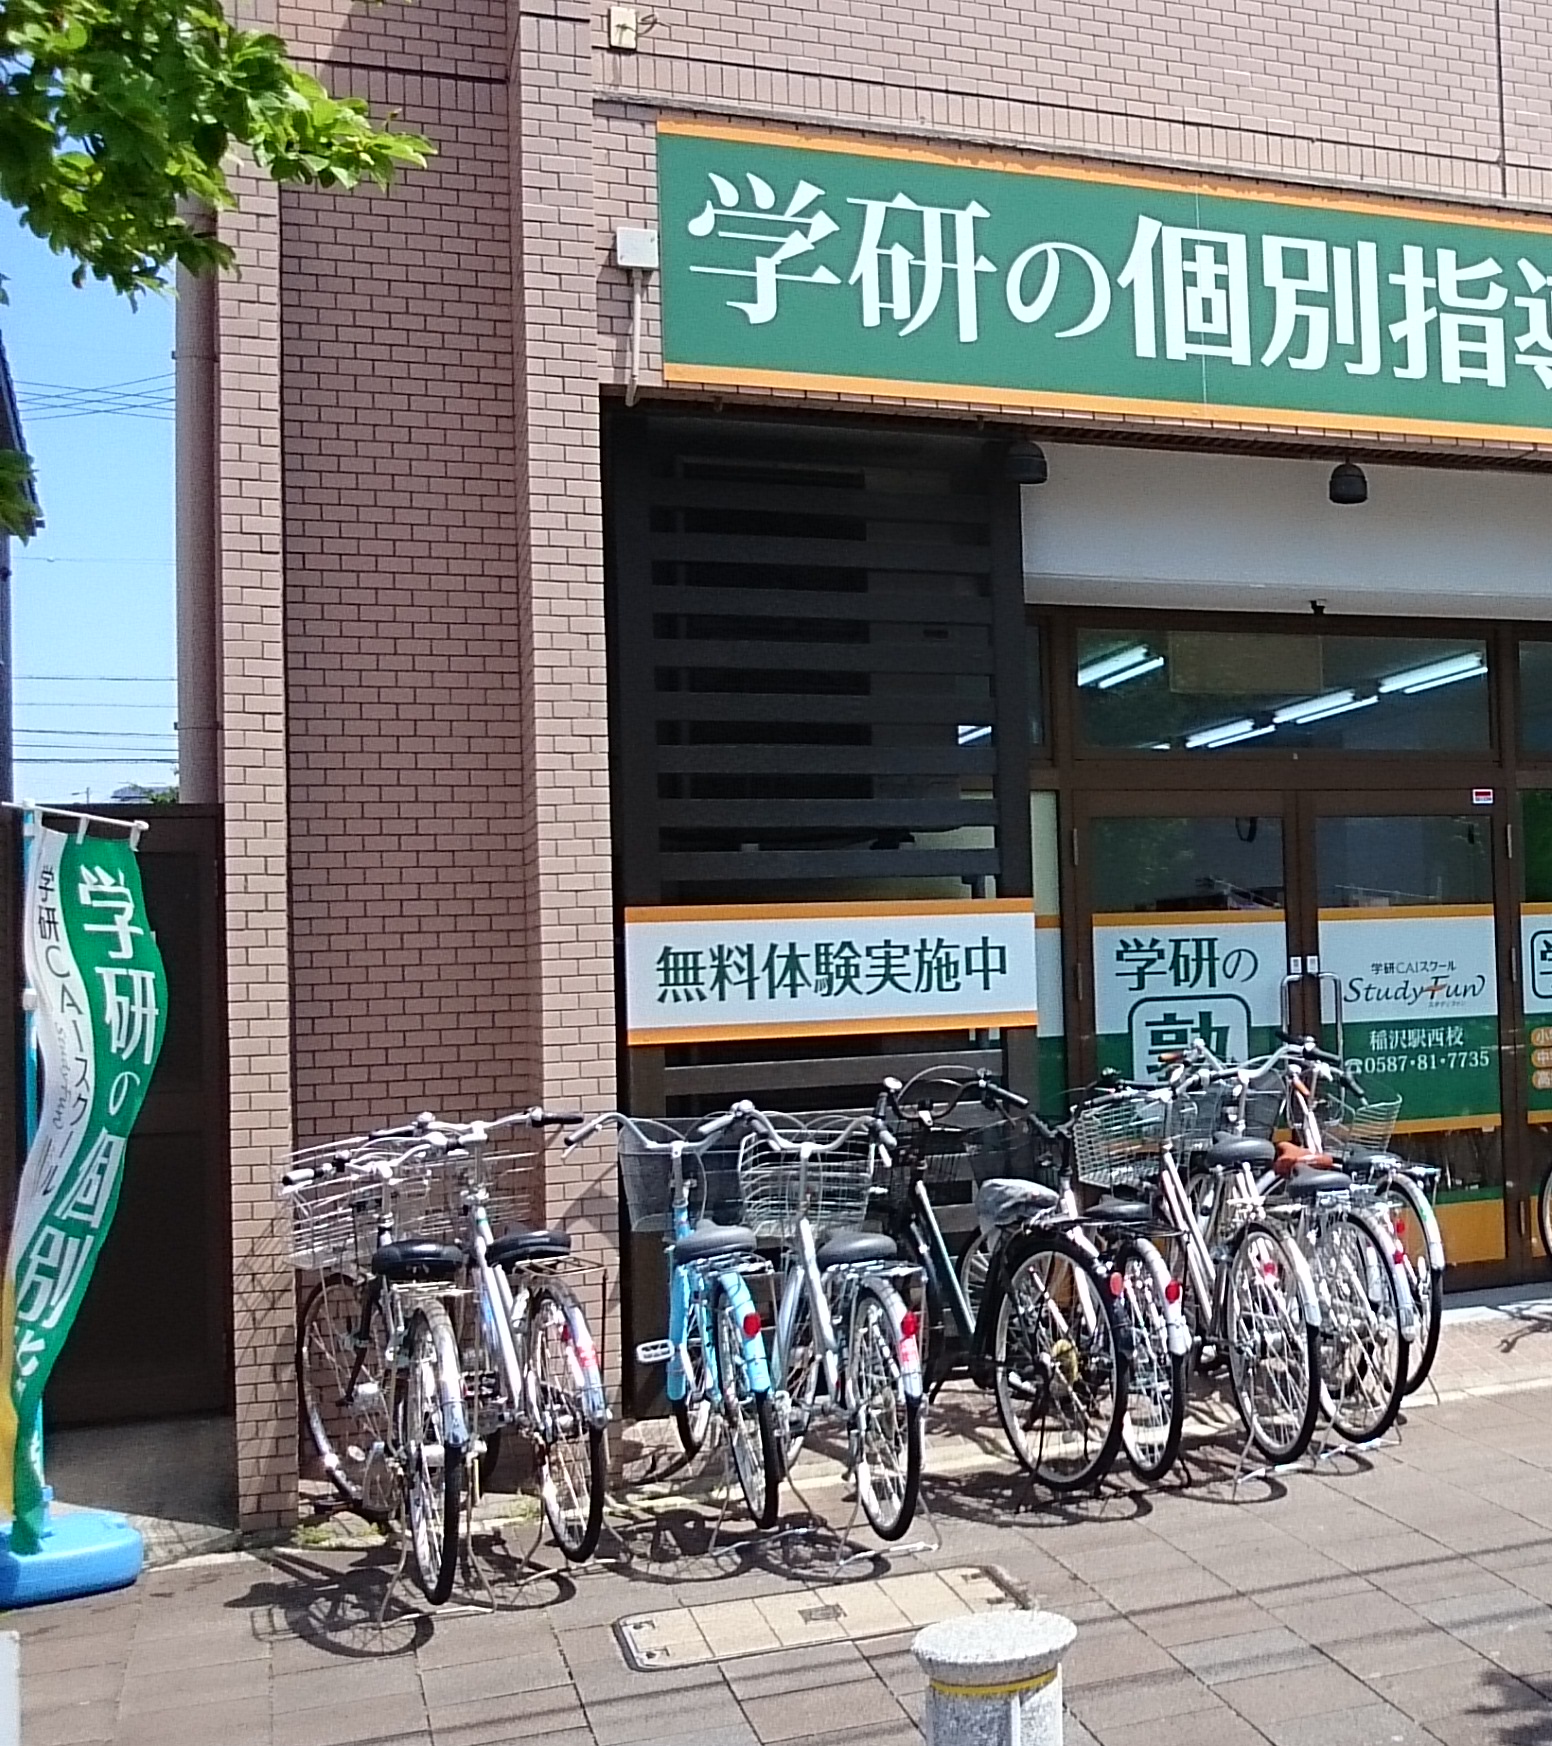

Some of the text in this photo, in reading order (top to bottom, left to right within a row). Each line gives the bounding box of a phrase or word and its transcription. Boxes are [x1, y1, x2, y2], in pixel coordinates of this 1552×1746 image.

[656, 935, 1008, 1004] 無料体験実施中
[1115, 936, 1260, 992] 学研の
[1371, 960, 1457, 975] 学研CAIスクール
[1369, 1025, 1465, 1051] 稲沢駅西校
